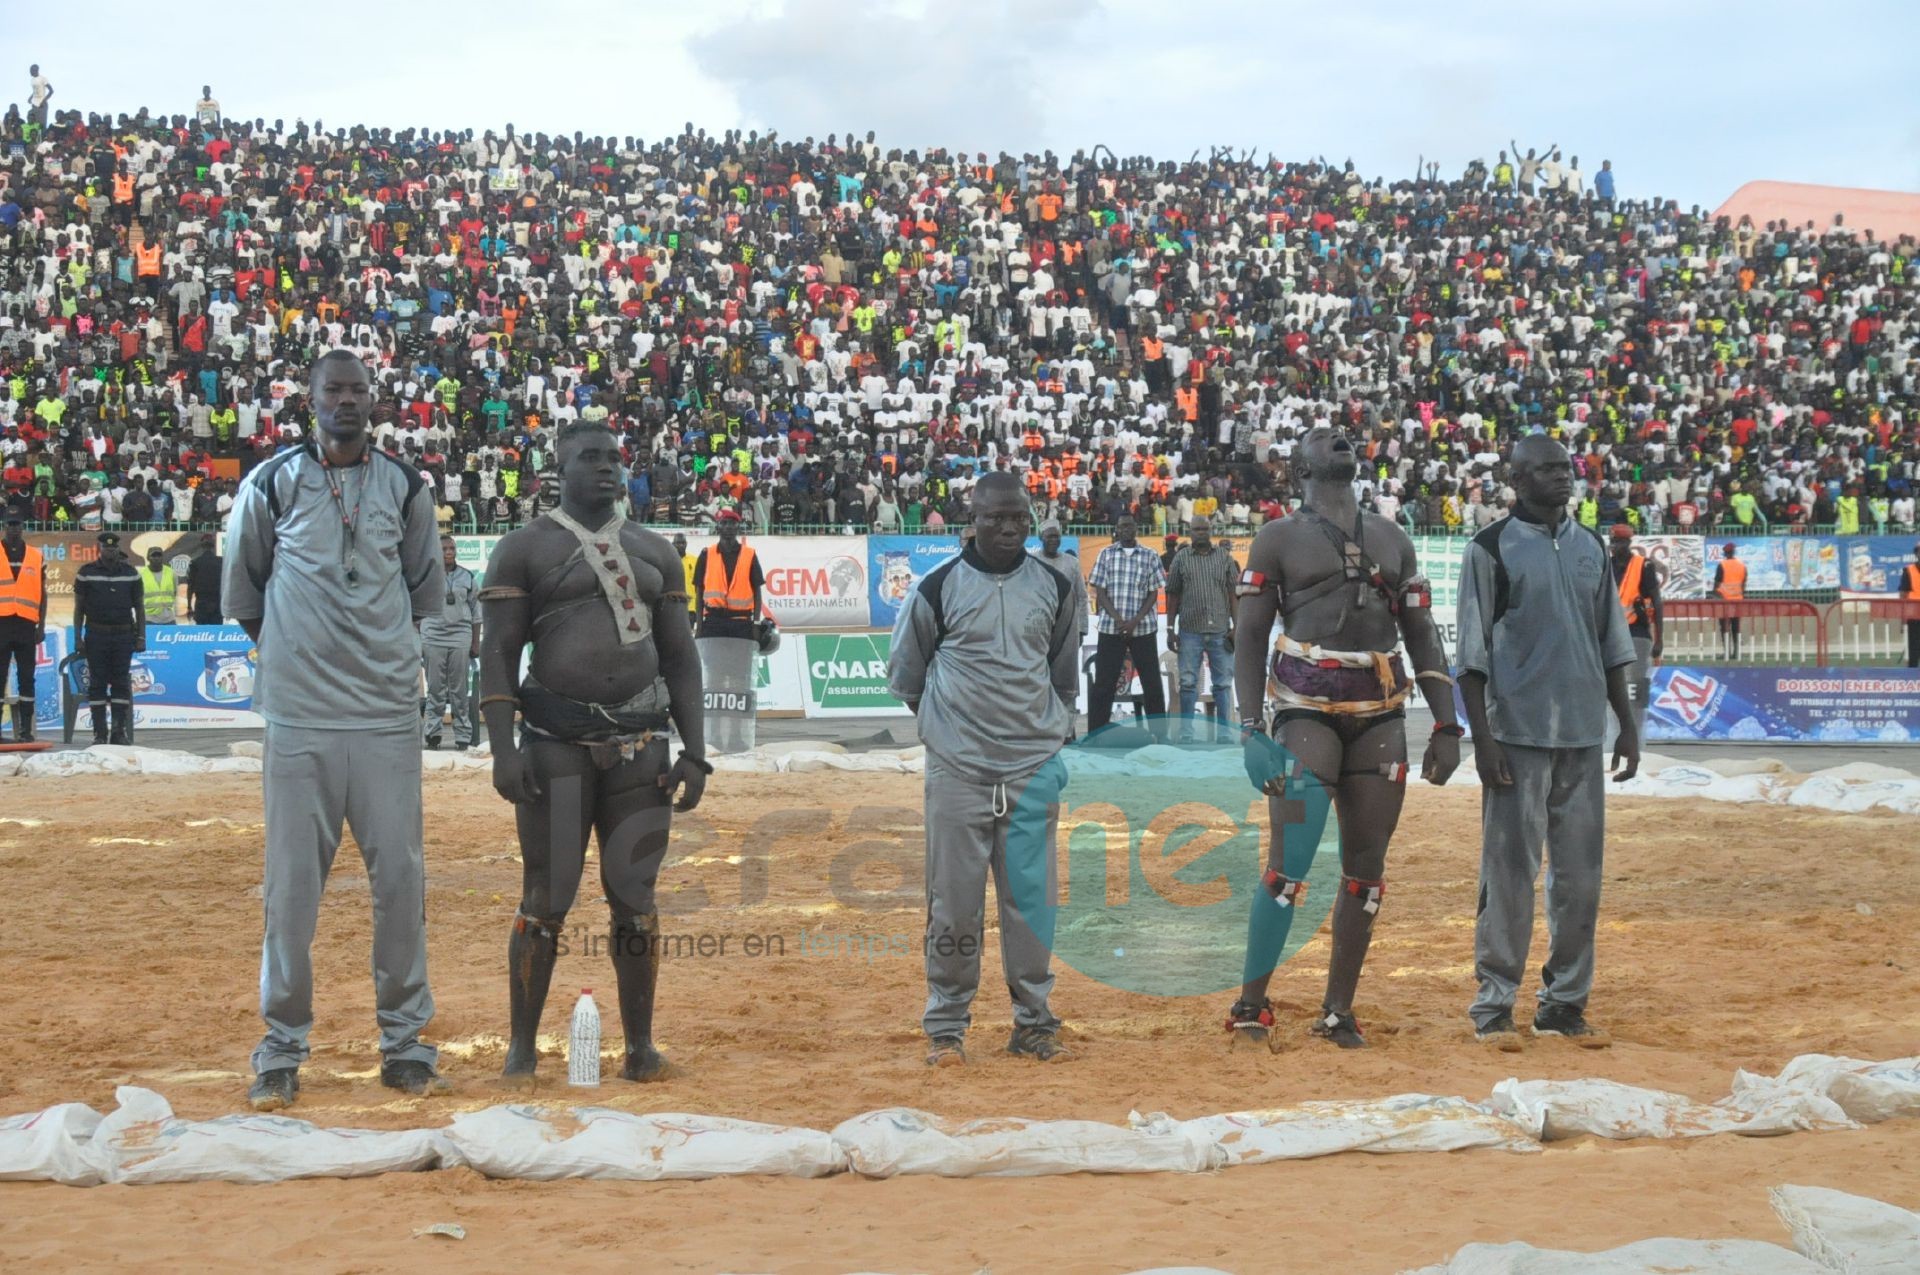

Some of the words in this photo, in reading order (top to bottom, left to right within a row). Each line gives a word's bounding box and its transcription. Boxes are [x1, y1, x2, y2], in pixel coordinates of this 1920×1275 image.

[766, 568, 830, 596] GFM
[768, 597, 858, 609] ENTERTAINMENT
[156, 630, 171, 642] La
[170, 631, 214, 645] famille
[218, 630, 252, 642] Laicr
[811, 660, 889, 679] CNAR
[827, 686, 889, 695] assurance
[1777, 680, 1842, 692] BOISSON
[704, 693, 747, 711] POLIC
